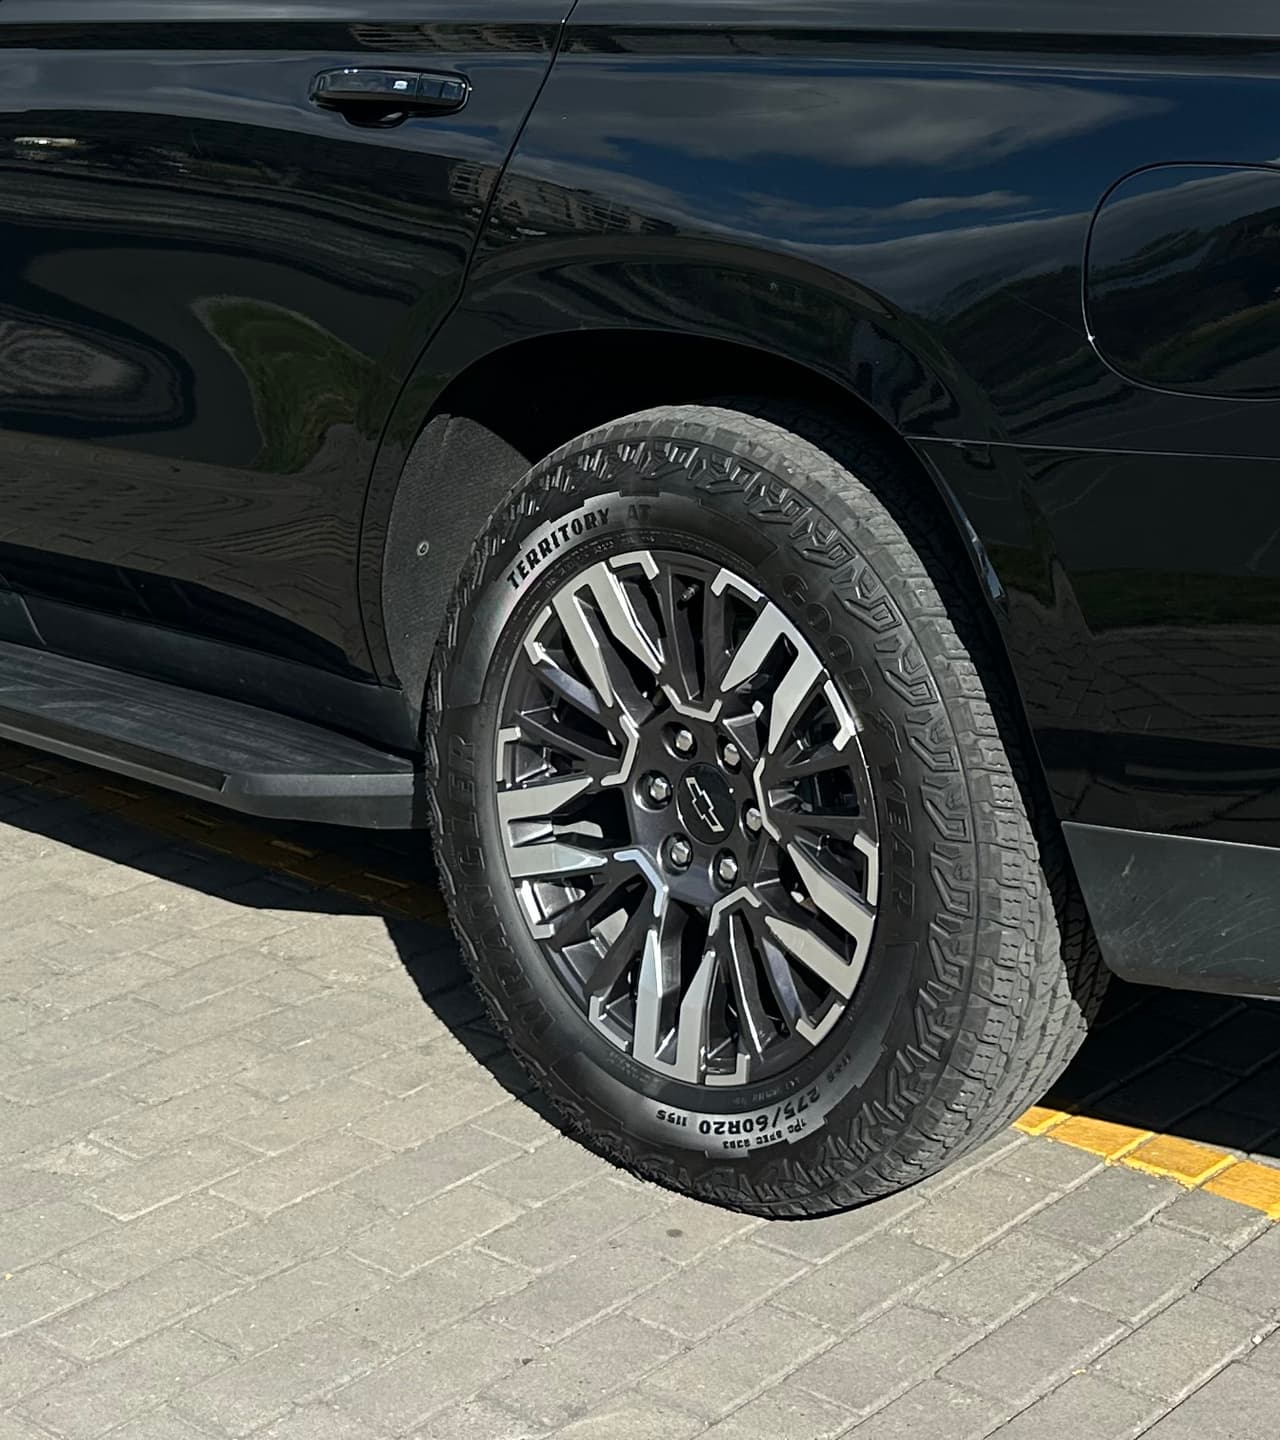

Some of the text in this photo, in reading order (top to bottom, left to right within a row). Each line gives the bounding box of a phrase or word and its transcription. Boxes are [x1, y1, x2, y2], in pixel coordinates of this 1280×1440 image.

[506, 503, 652, 590] TERRITORY AT
[655, 1110, 688, 1128] 115S
[698, 1085, 821, 1135] 275/60R20
